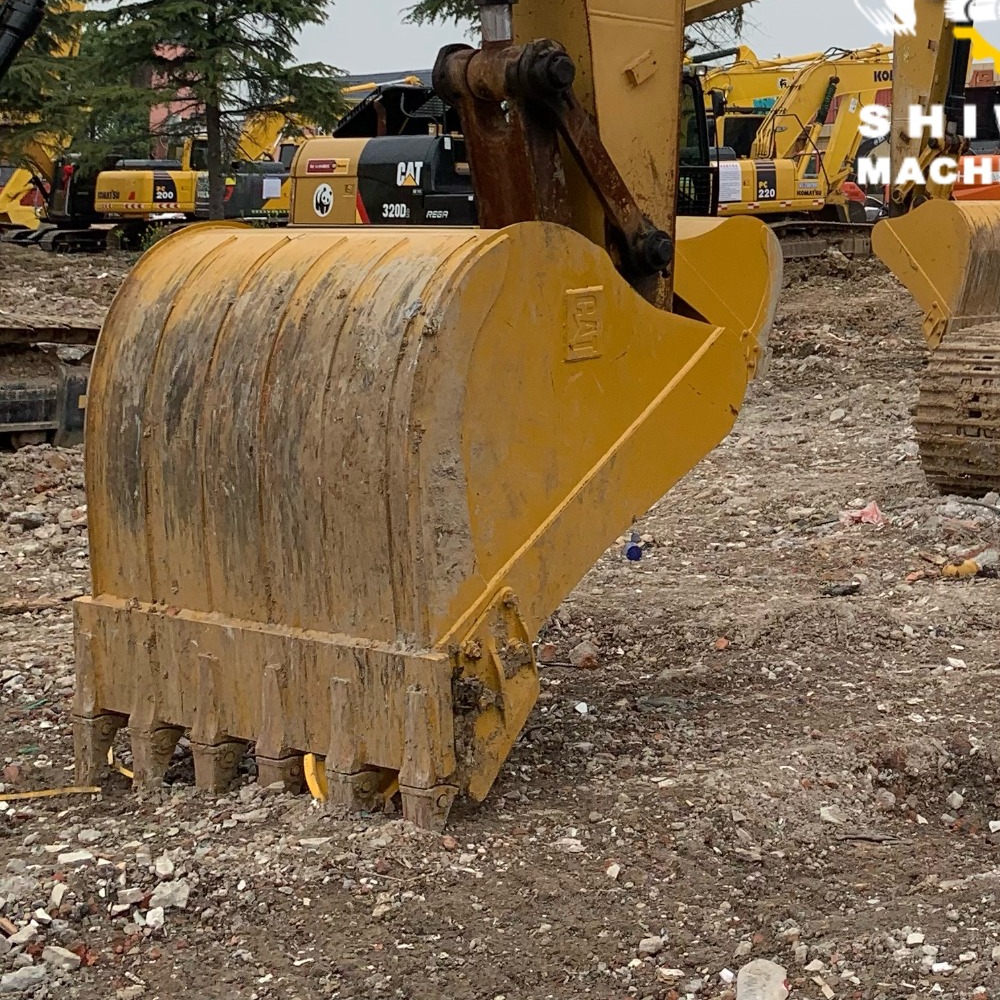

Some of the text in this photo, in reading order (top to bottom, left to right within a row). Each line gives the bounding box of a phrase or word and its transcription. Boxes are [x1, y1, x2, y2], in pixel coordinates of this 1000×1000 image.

[873, 70, 893, 83] KO
[396, 161, 424, 187] CAT
[758, 180, 768, 189] PC
[156, 191, 174, 199] 200
[758, 188, 776, 198] 220
[426, 210, 449, 219] REGA
